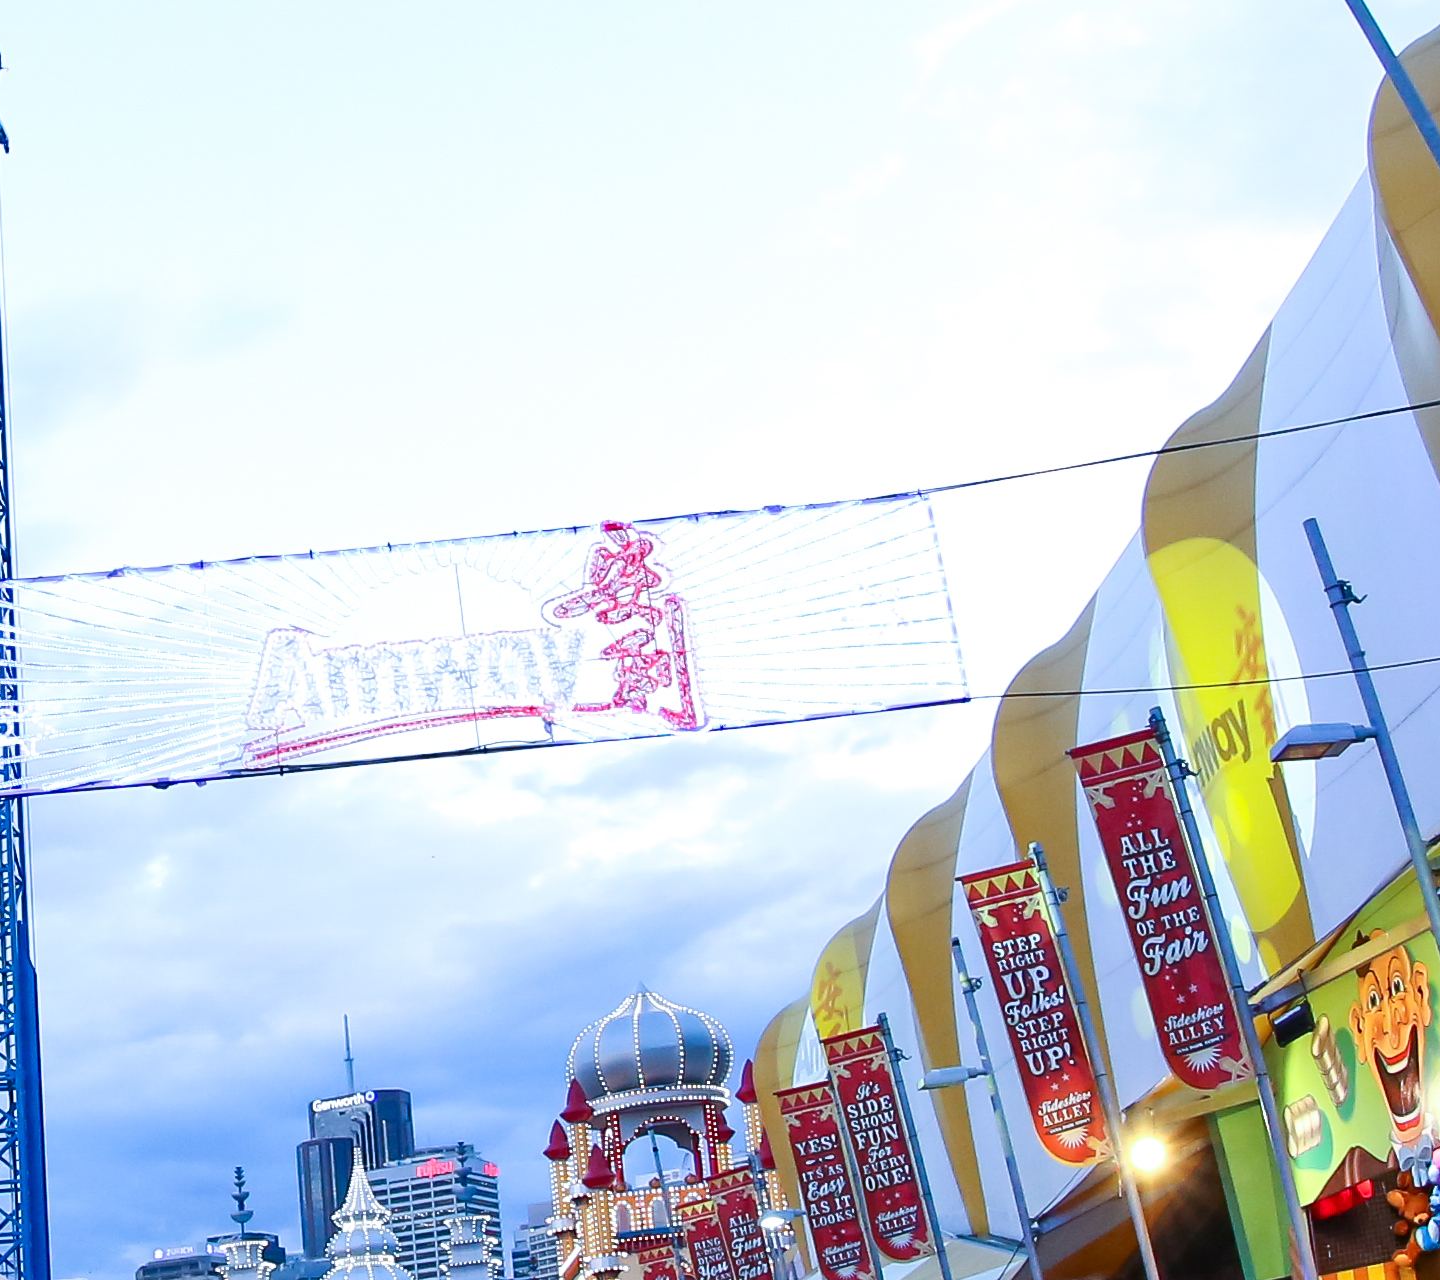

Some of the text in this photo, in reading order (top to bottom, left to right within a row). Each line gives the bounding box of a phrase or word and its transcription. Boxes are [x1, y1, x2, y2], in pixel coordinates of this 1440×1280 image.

[246, 626, 586, 730] Amway
[1120, 828, 1169, 857] ALL
[1123, 849, 1176, 879] THE
[1126, 875, 1192, 920] Fun
[1136, 906, 1200, 937] OF THE
[992, 933, 1041, 959] STEP
[1142, 926, 1209, 976] Fair
[996, 949, 1045, 973] RIGHT
[1001, 965, 1050, 1000] UP
[1004, 984, 1065, 1026] Folks!
[1164, 1003, 1224, 1032] Sideshow
[1015, 1011, 1064, 1039] STEP
[1169, 1015, 1225, 1046] ALLEY
[1020, 1027, 1068, 1052] RIGHT
[1024, 1042, 1075, 1077] UP!
[856, 1081, 881, 1100] It's
[846, 1095, 893, 1118] SIDE
[1038, 1091, 1091, 1116] Sideshow
[1043, 1101, 1091, 1127] ALLEY
[850, 1110, 895, 1132] SHOW
[795, 1133, 838, 1156] YES!
[854, 1123, 899, 1151] FUN
[828, 1164, 844, 1176] AS
[863, 1153, 906, 1176] EVERY
[807, 1176, 846, 1201] Easy
[864, 1164, 912, 1192] ONE!
[810, 1194, 851, 1216] AS IT
[729, 1213, 754, 1228] ALL
[730, 1223, 756, 1239] THE
[812, 1208, 855, 1229] LOOKS!
[879, 1213, 917, 1232] ALLEY
[694, 1237, 721, 1251] RING
[731, 1237, 763, 1258] Fun
[749, 1251, 766, 1262] THE
[825, 1248, 861, 1265] ALLEY
[698, 1252, 725, 1266] DING!
